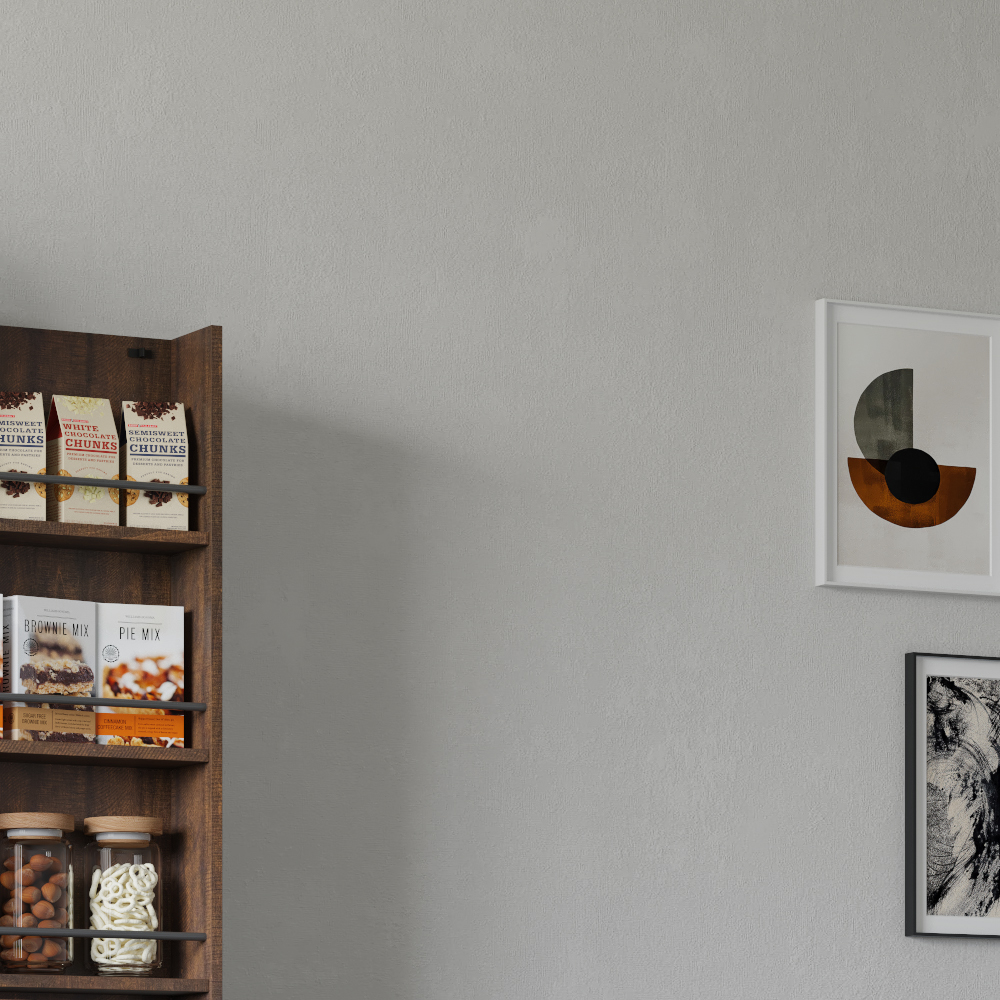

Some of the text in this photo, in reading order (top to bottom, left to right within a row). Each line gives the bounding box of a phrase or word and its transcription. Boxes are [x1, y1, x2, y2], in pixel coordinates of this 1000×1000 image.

[63, 423, 99, 432] WHITE
[65, 431, 116, 440] CHOCOLATE
[66, 438, 117, 450] CHUNKS
[130, 444, 186, 453] CHUNKS
[25, 619, 89, 637] BROWNIE MIX
[119, 626, 160, 641] PIE MIX
